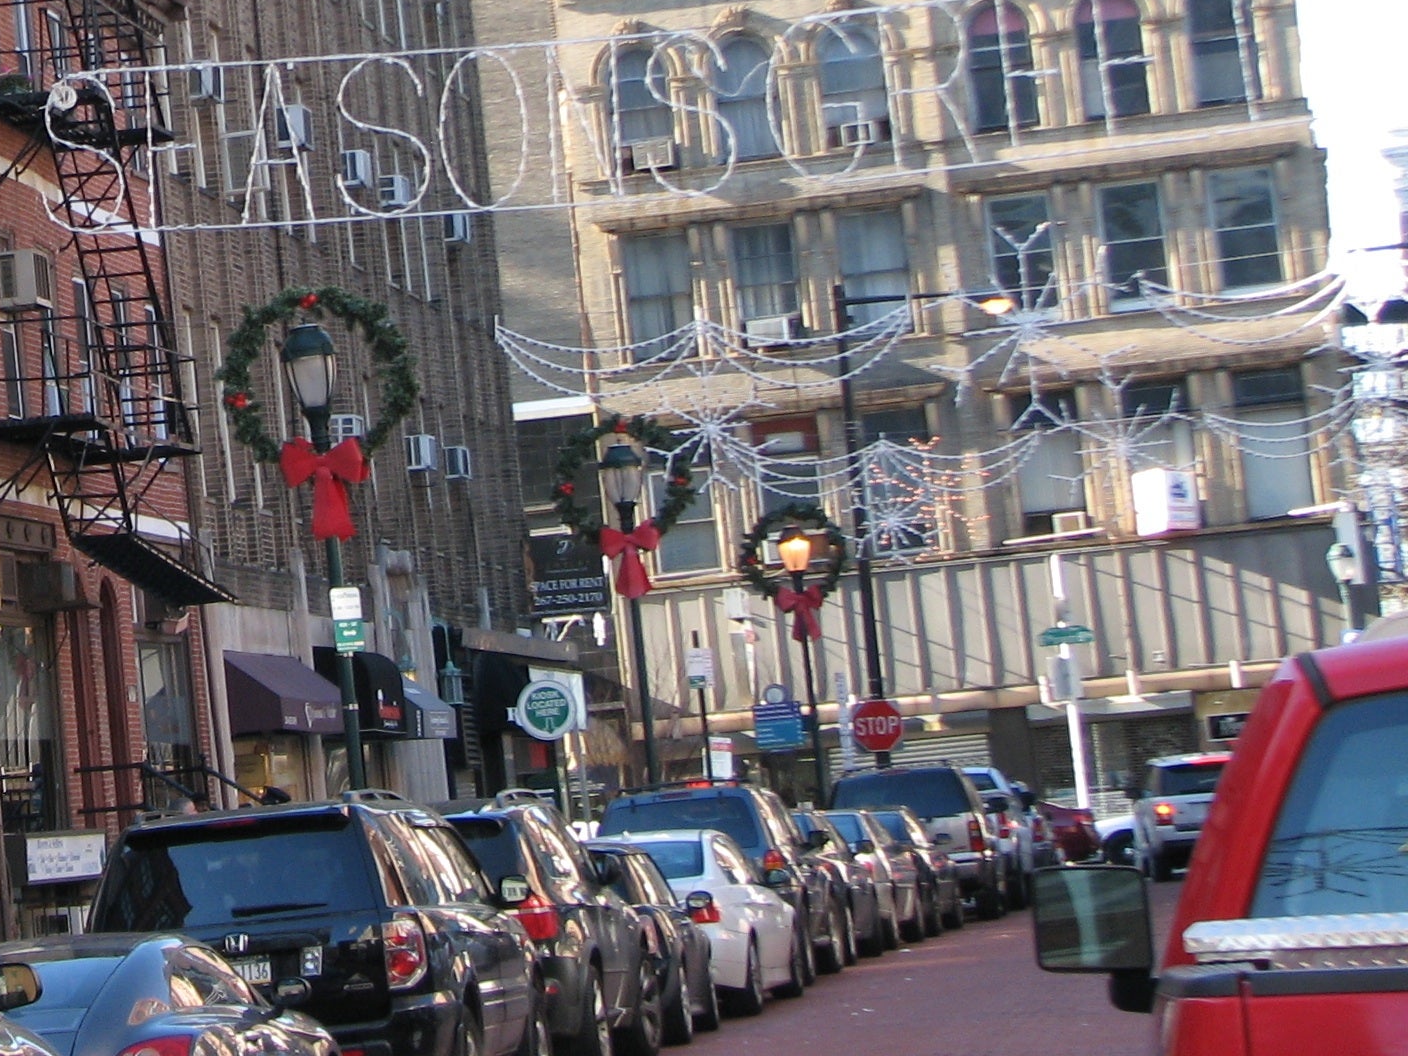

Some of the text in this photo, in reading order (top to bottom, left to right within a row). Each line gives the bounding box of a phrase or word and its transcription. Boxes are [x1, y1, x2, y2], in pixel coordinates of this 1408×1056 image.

[559, 578, 578, 590] FOR
[579, 576, 603, 589] RENT
[527, 698, 566, 710] LOCATED
[855, 715, 900, 737] STOP
